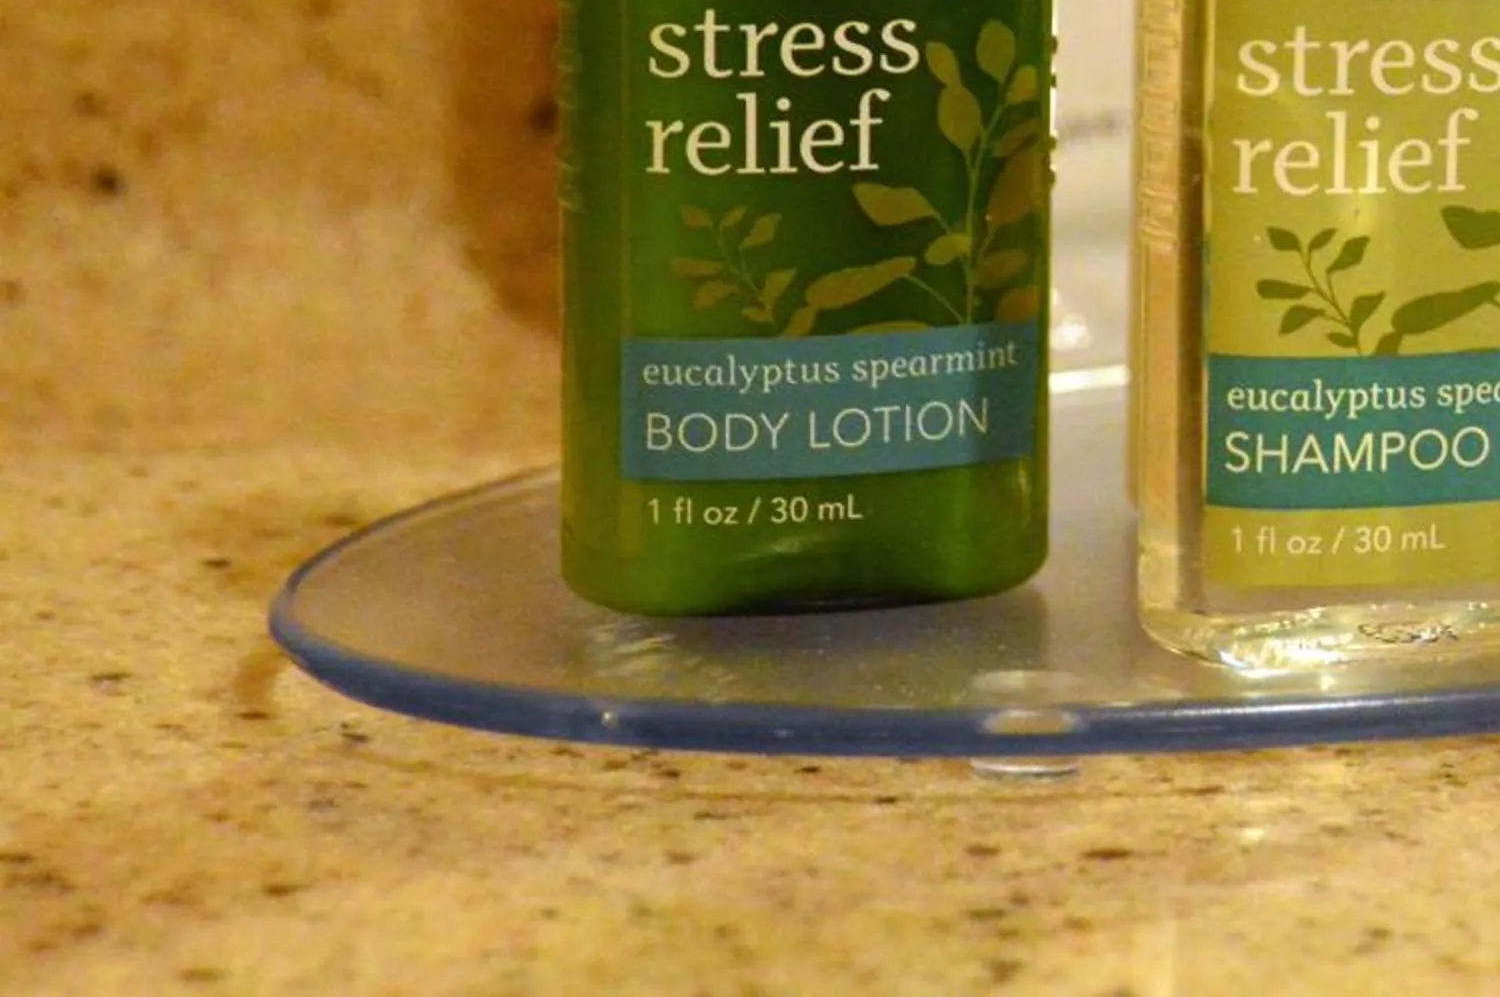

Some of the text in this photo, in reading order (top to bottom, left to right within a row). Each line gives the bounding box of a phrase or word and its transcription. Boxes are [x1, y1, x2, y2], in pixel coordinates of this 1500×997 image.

[649, 8, 920, 78] stress
[645, 89, 890, 175] relief
[1231, 108, 1479, 196] relief
[643, 342, 1018, 395] eucalyptus spearmint
[646, 397, 989, 452] BODY LOTION
[1227, 379, 1425, 420] eucalyptus
[1225, 426, 1491, 474] SHAMPOO
[648, 493, 863, 525] 1 fl oz / 30 mL
[1232, 523, 1446, 555] 1 fl oz / 30 mL
